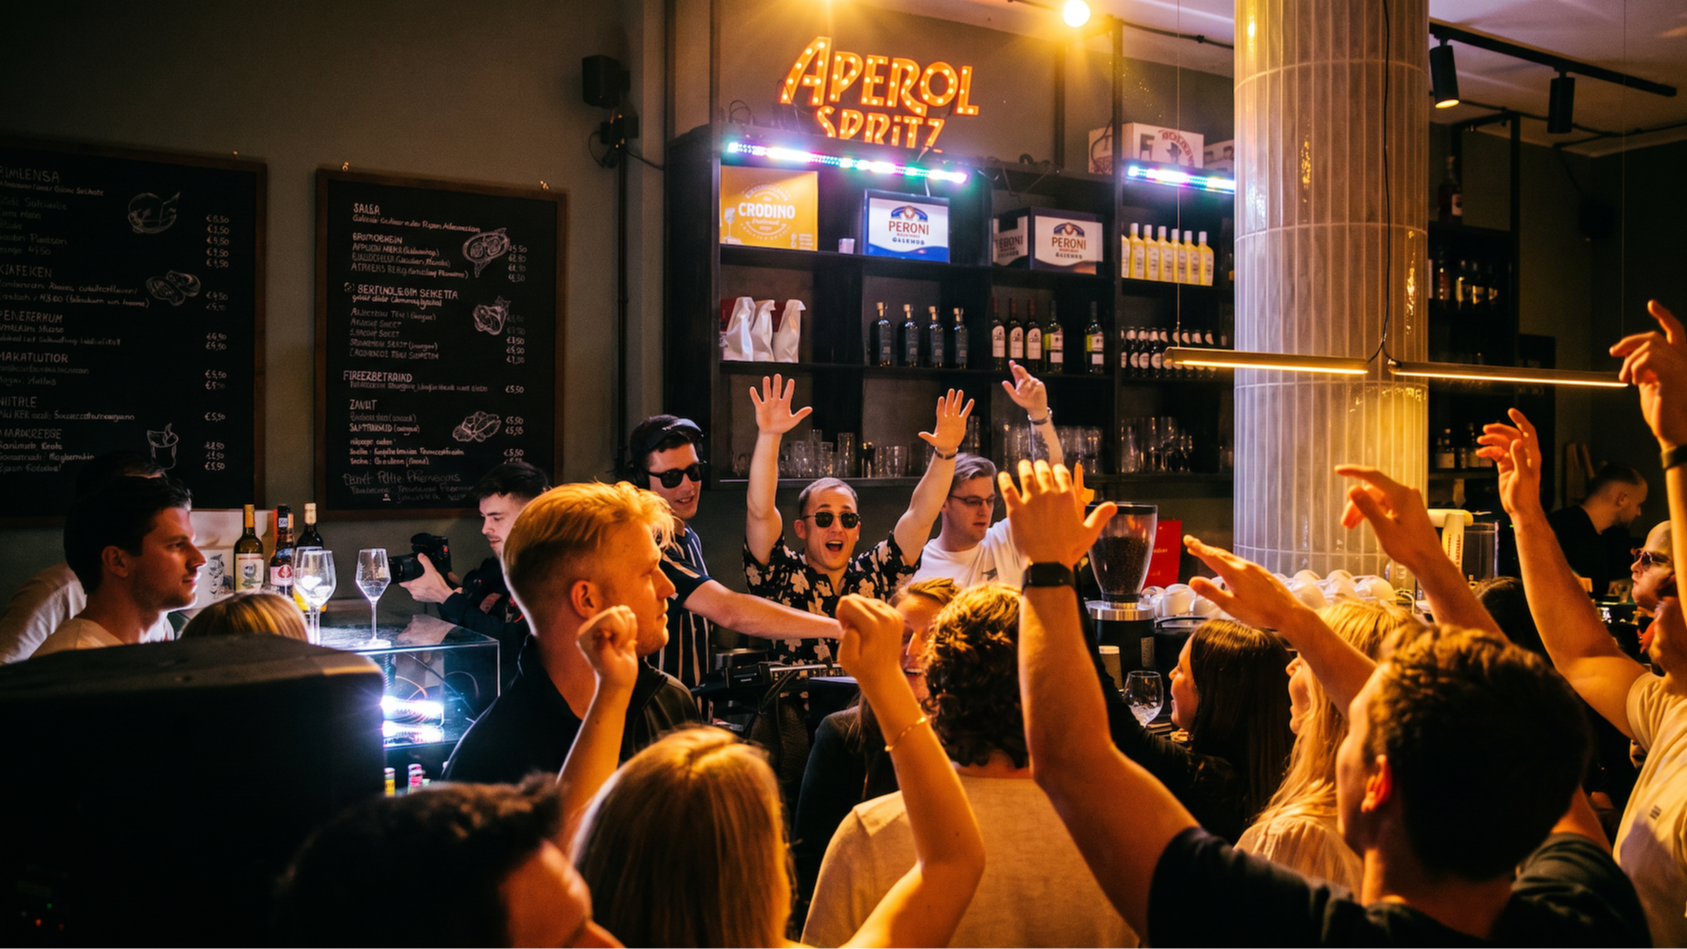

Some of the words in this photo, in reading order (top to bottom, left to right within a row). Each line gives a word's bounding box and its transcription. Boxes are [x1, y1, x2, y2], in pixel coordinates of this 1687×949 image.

[780, 36, 979, 117] APEROL
[738, 202, 796, 219] CRODINO
[888, 220, 929, 235] PERONI
[1051, 236, 1087, 251] PERONI
